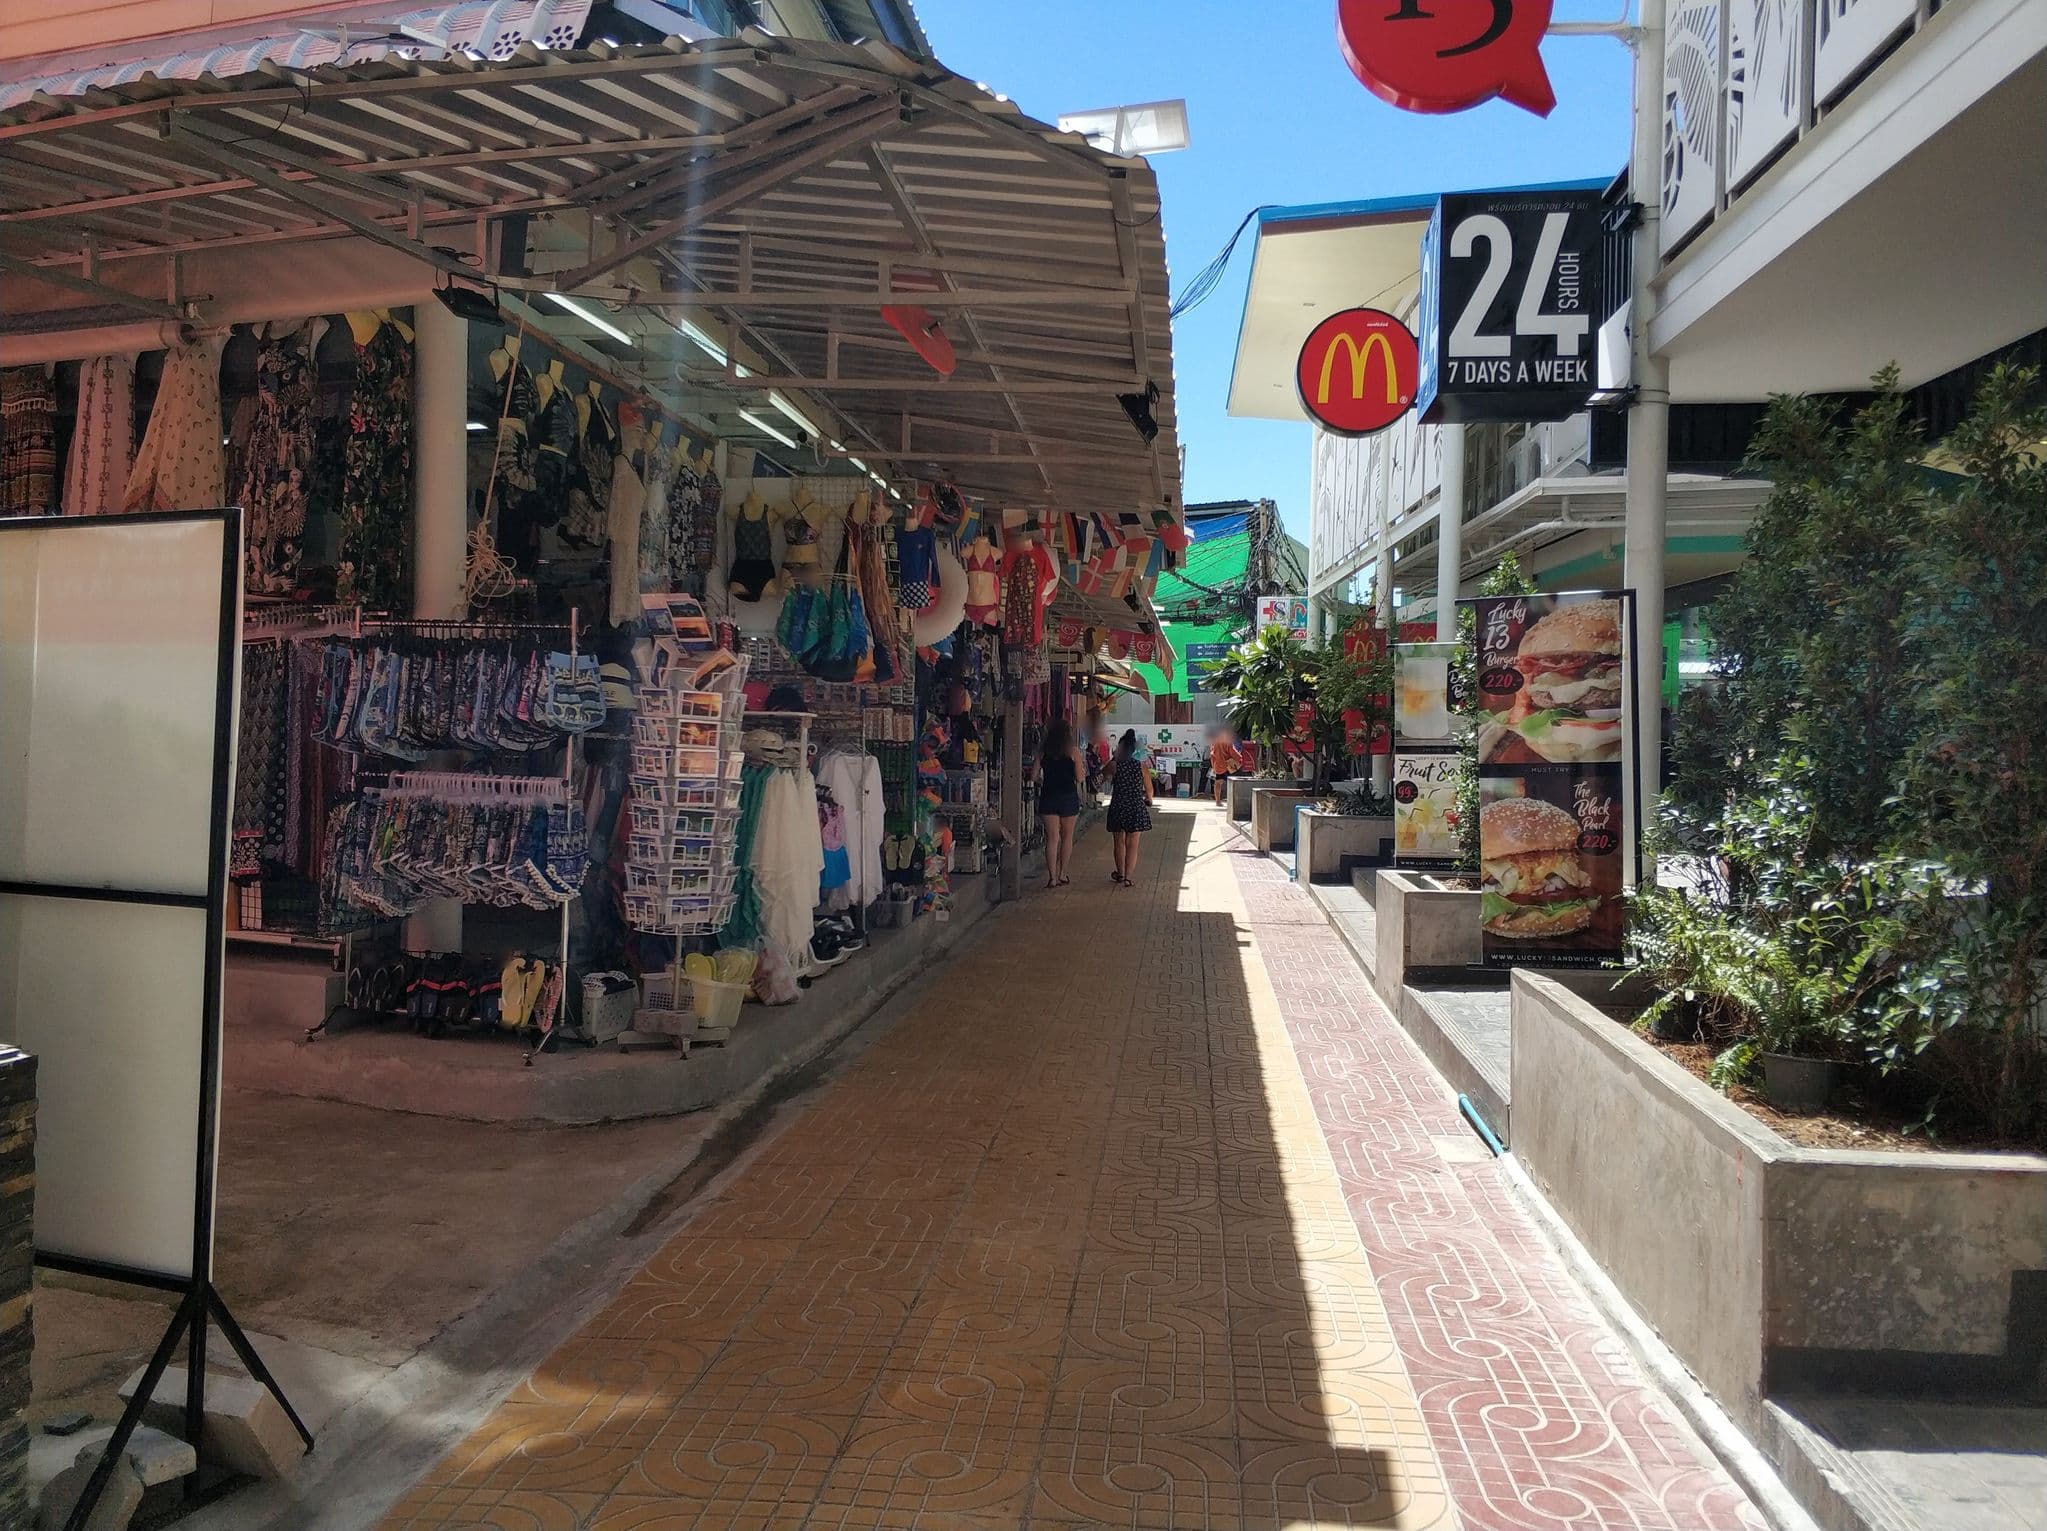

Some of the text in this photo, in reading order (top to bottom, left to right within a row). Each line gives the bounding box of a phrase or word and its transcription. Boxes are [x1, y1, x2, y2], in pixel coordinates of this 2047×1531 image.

[1448, 213, 1589, 357] 24
[1447, 360, 1588, 383] 7 DAYS A WEEK
[1487, 598, 1527, 625] Lucky
[1482, 624, 1510, 651] 13
[1482, 651, 1520, 670] Burger
[1398, 759, 1435, 782] Fruit
[1573, 780, 1591, 799] The
[1572, 797, 1612, 817] Black
[1581, 816, 1610, 831] Pearl
